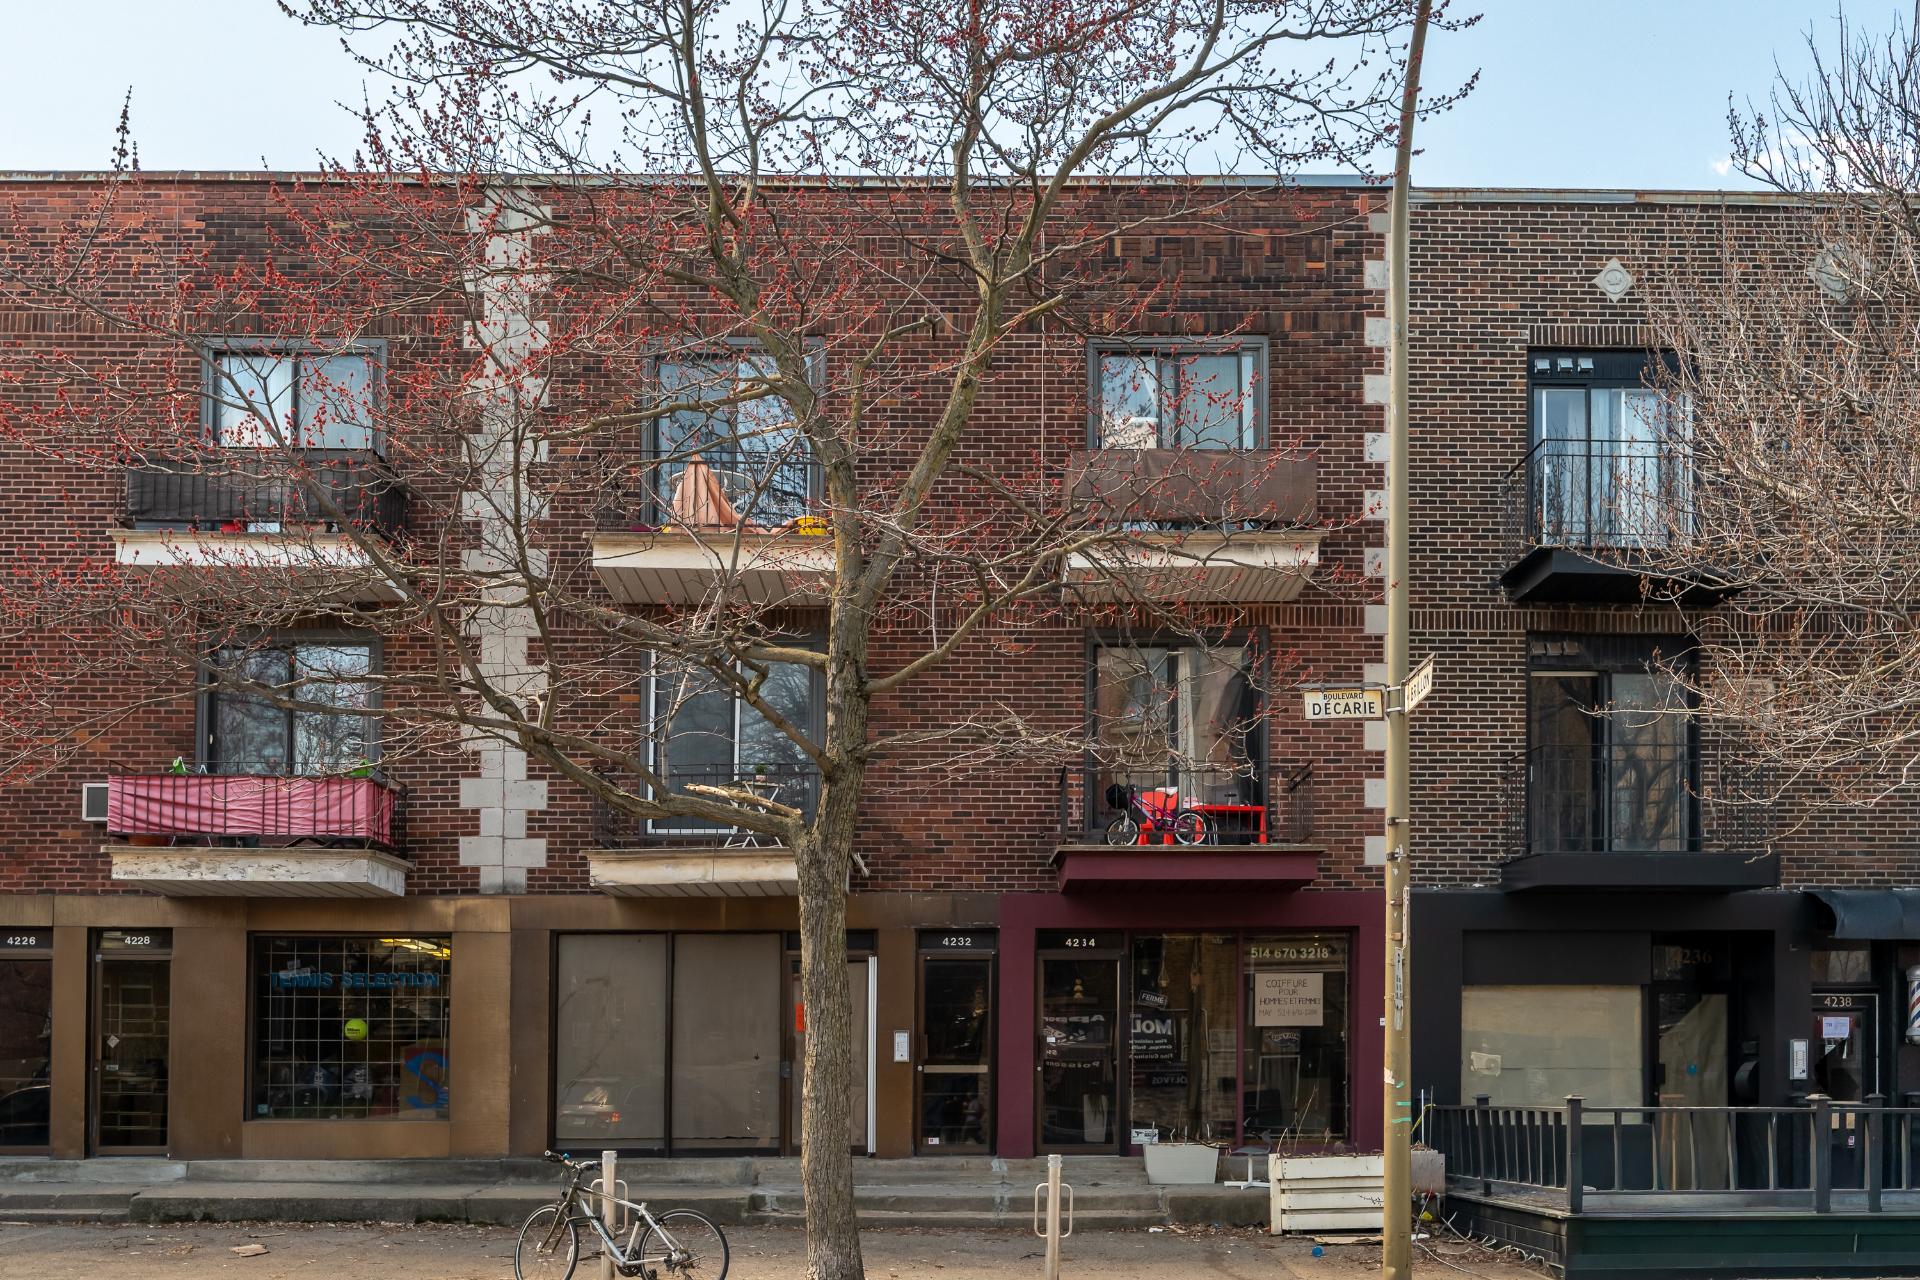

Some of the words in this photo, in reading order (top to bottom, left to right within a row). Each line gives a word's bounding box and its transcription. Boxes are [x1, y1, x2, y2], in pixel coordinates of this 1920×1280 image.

[1323, 692, 1364, 701] BOULEVARD
[1312, 700, 1376, 716] DÉCARIE
[7, 936, 36, 945] 4226
[124, 936, 150, 945] 4228
[942, 937, 972, 946] 4232
[1065, 938, 1096, 947] 4234
[1250, 947, 1271, 959] 514
[1274, 948, 1297, 959] 670
[1300, 948, 1329, 959] 3218
[270, 972, 333, 988] TENNIS
[341, 972, 439, 988] SELECTION
[1265, 979, 1308, 988] COIFFURE
[1278, 988, 1298, 996] POUR
[1259, 998, 1288, 1006] HOMMES
[1824, 996, 1852, 1007] 4238
